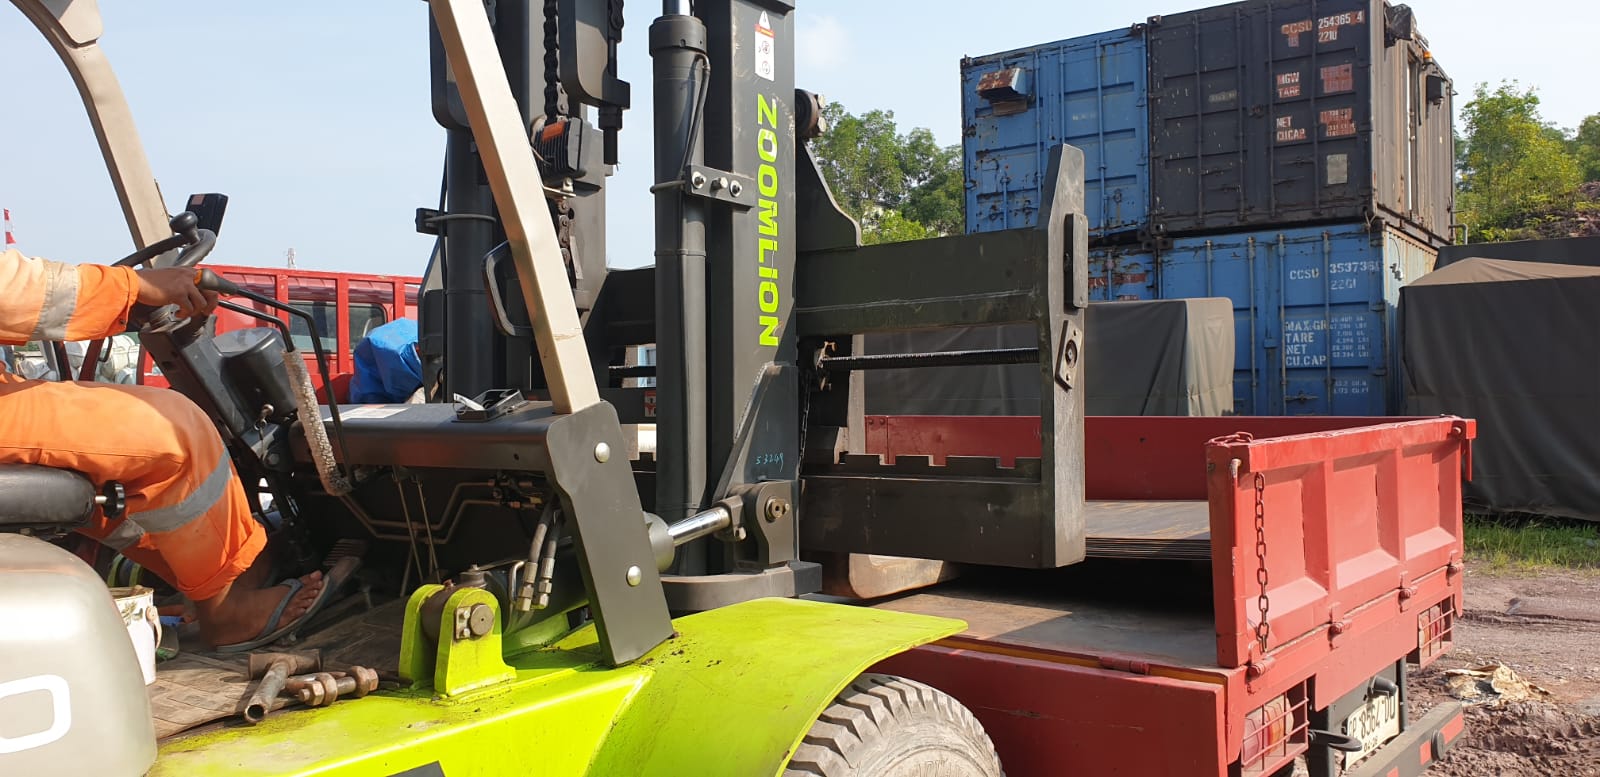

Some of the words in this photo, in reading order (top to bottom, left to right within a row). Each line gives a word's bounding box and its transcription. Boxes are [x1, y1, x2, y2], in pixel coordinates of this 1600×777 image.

[1279, 86, 1300, 98] TARE
[1276, 116, 1292, 128] NET
[757, 93, 780, 347] ZOOMLION
[1289, 268, 1320, 280] CCSU
[1285, 332, 1315, 343] TARE
[1286, 344, 1307, 355] NET
